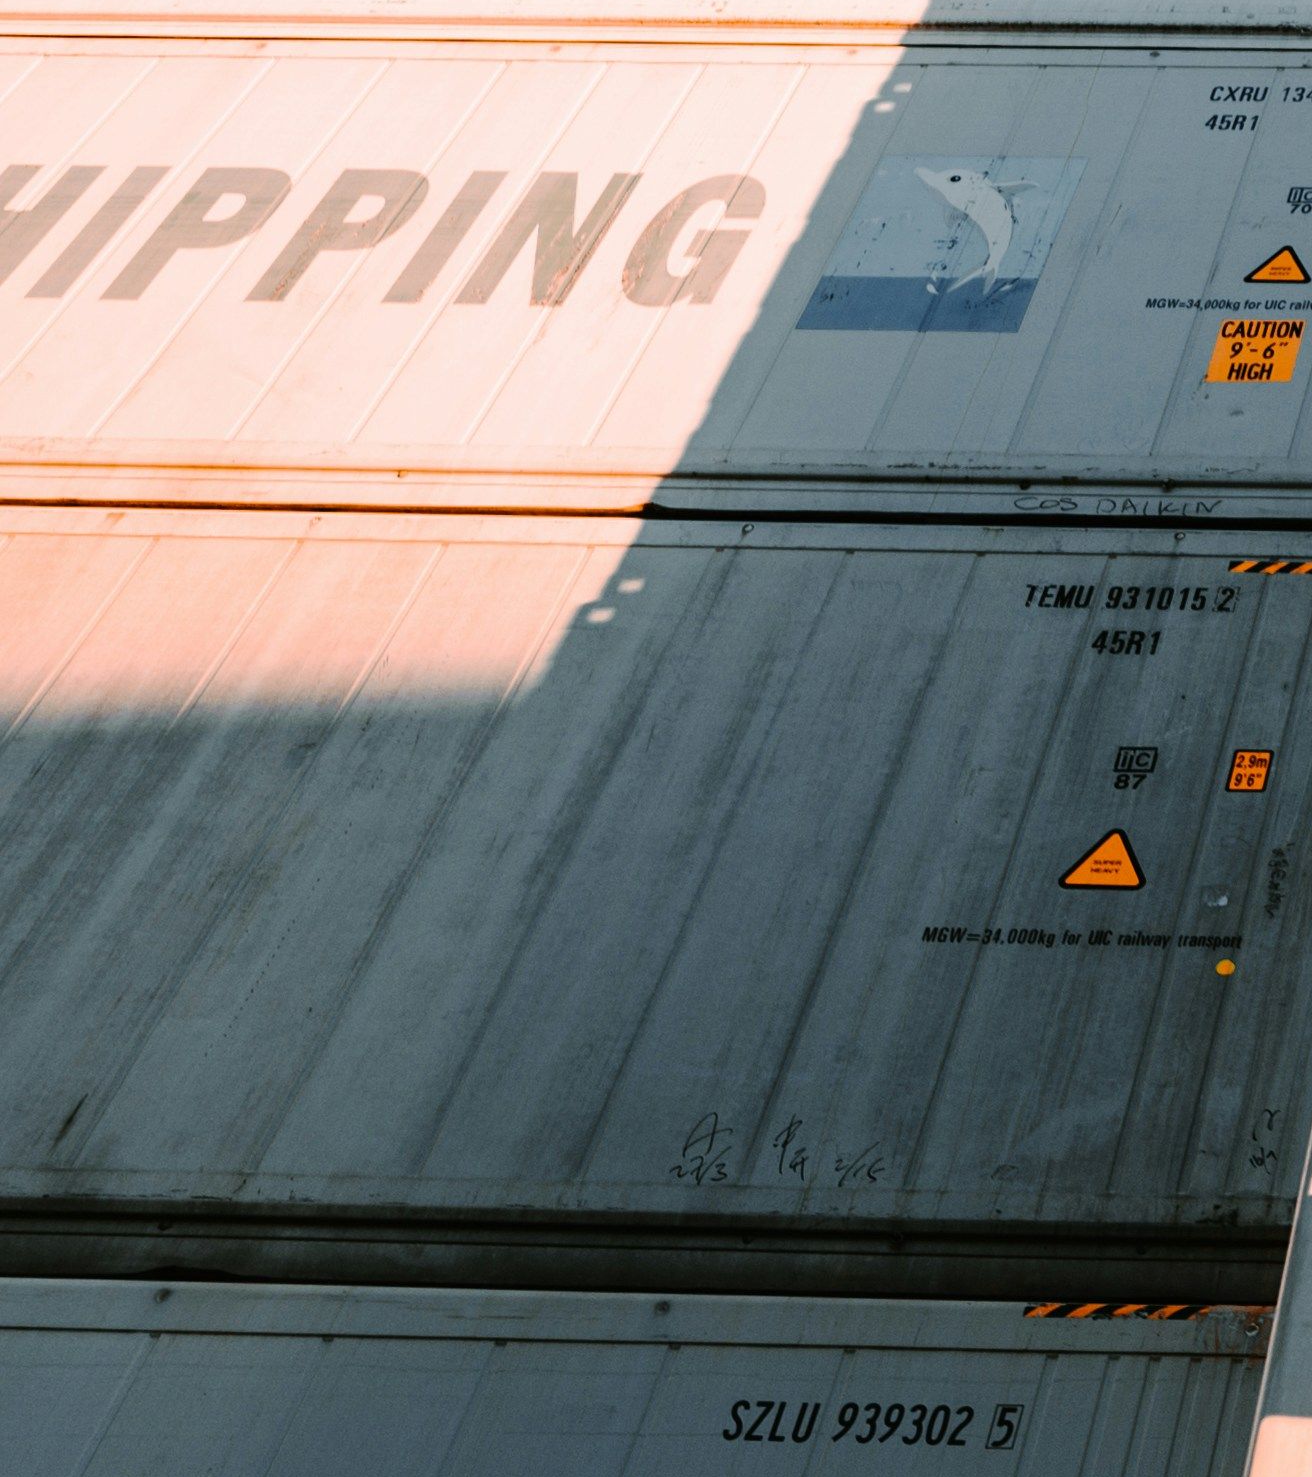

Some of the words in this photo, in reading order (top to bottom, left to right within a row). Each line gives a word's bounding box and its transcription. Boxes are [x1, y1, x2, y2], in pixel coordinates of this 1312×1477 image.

[1210, 86, 1269, 101] CXRU
[1205, 115, 1259, 131] 45R1
[1291, 204, 1312, 214] 70
[1243, 300, 1262, 310] for
[1264, 300, 1286, 310] UIC
[1221, 321, 1304, 339] CAUTION
[1227, 363, 1274, 381] HIGH
[1025, 584, 1095, 609] TEMU
[1106, 586, 1208, 611] 931015
[1217, 589, 1236, 612] 2
[1091, 631, 1162, 655] 45R1
[1114, 774, 1147, 790] 87
[1061, 930, 1082, 946] for
[1088, 930, 1112, 946] UIC
[1117, 931, 1172, 949] railway
[1177, 933, 1243, 951] transport
[722, 1400, 821, 1443] SZLU
[831, 1403, 975, 1446] 939302
[989, 1408, 1016, 1448] 5
